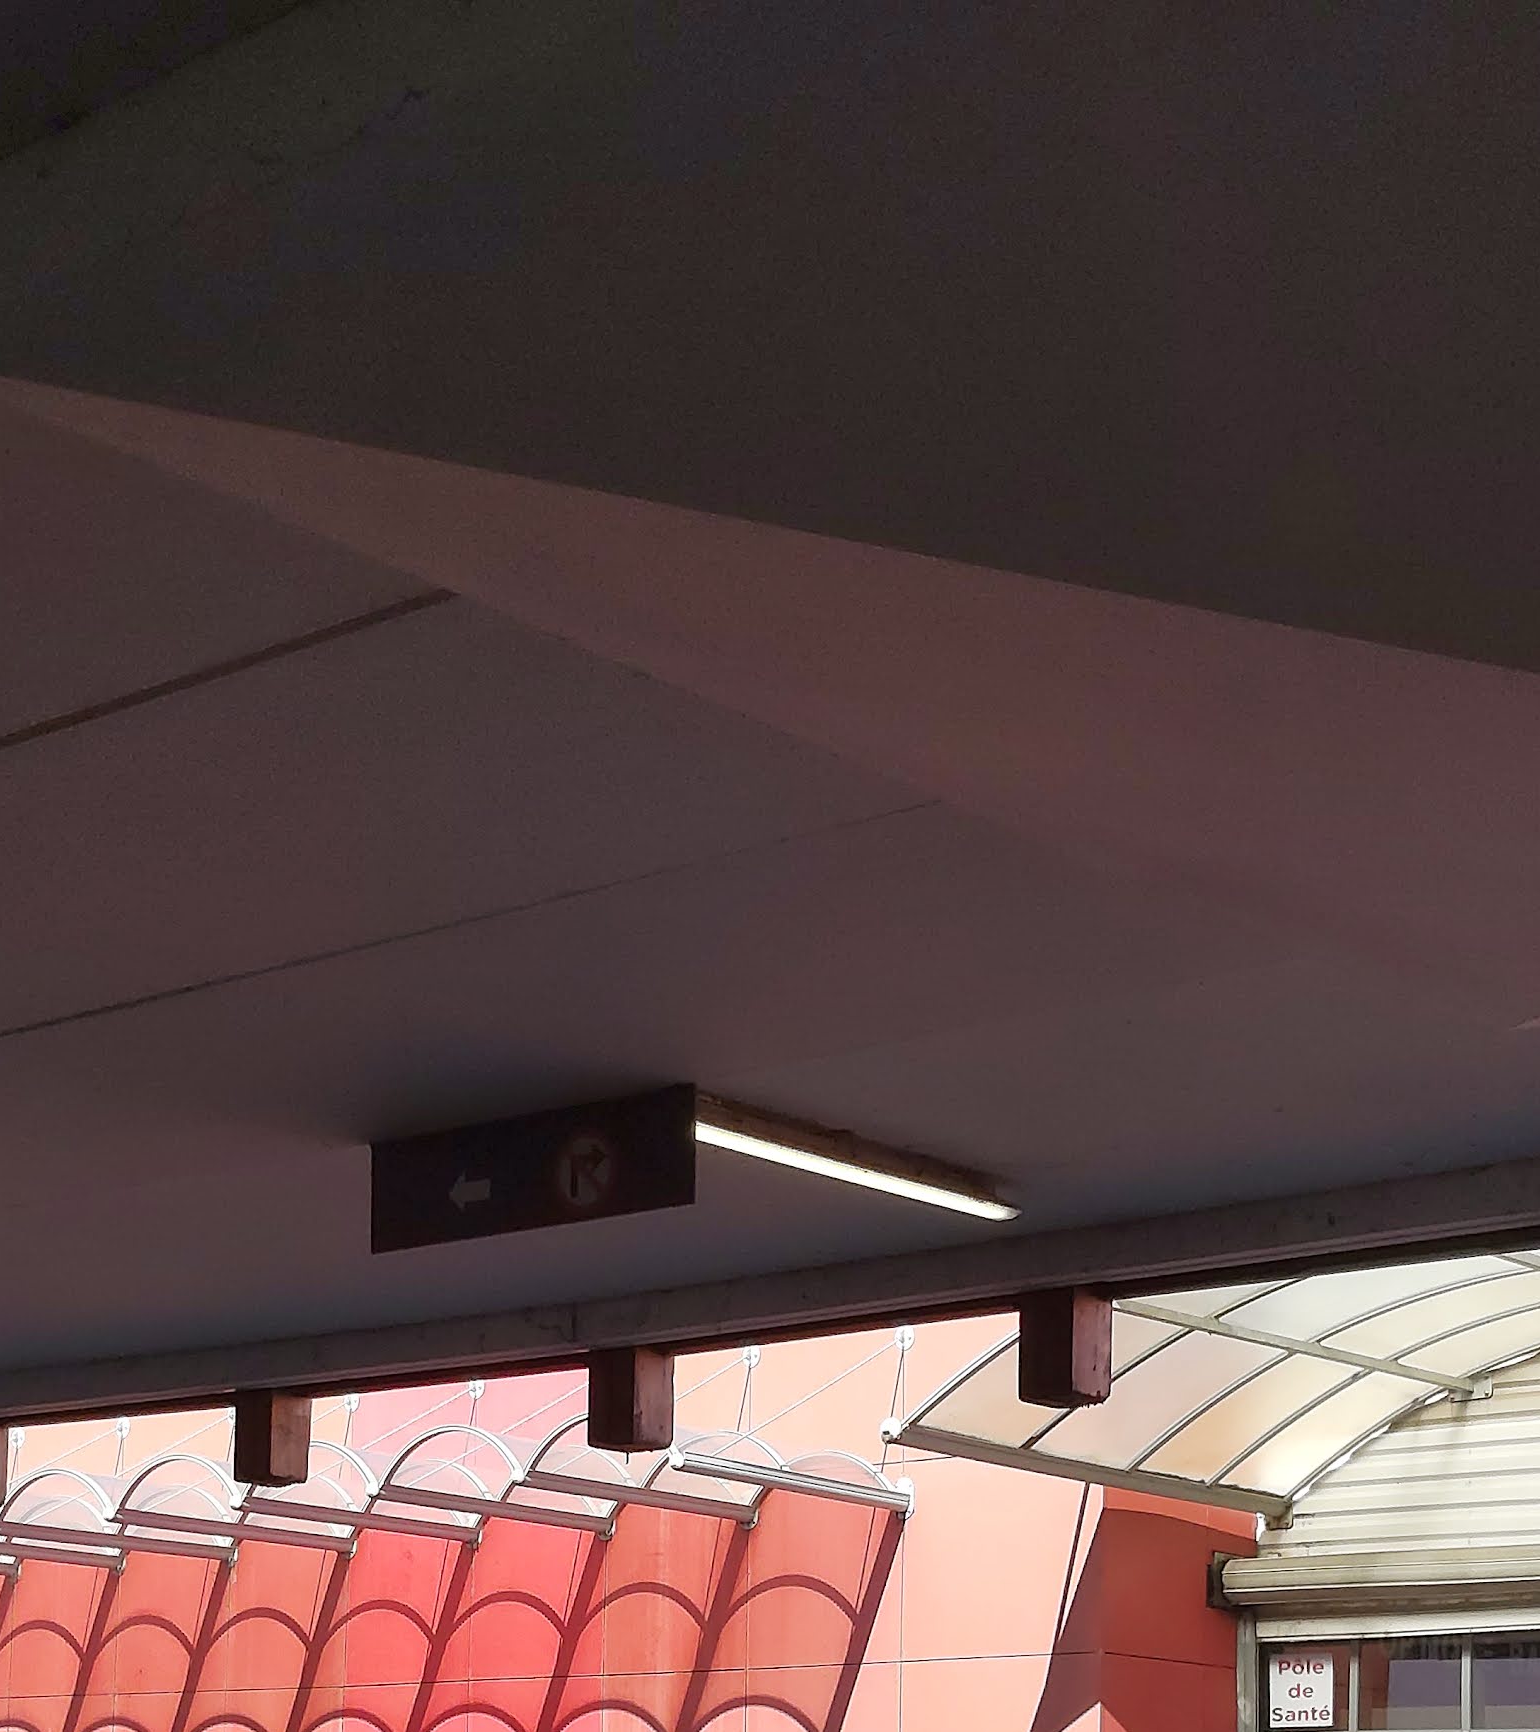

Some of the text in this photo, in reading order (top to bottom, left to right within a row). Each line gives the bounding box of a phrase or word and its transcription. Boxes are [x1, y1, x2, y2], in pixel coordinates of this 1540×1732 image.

[1278, 1657, 1324, 1675] Pôle
[1288, 1683, 1314, 1698] de
[1272, 1705, 1330, 1722] Santé
